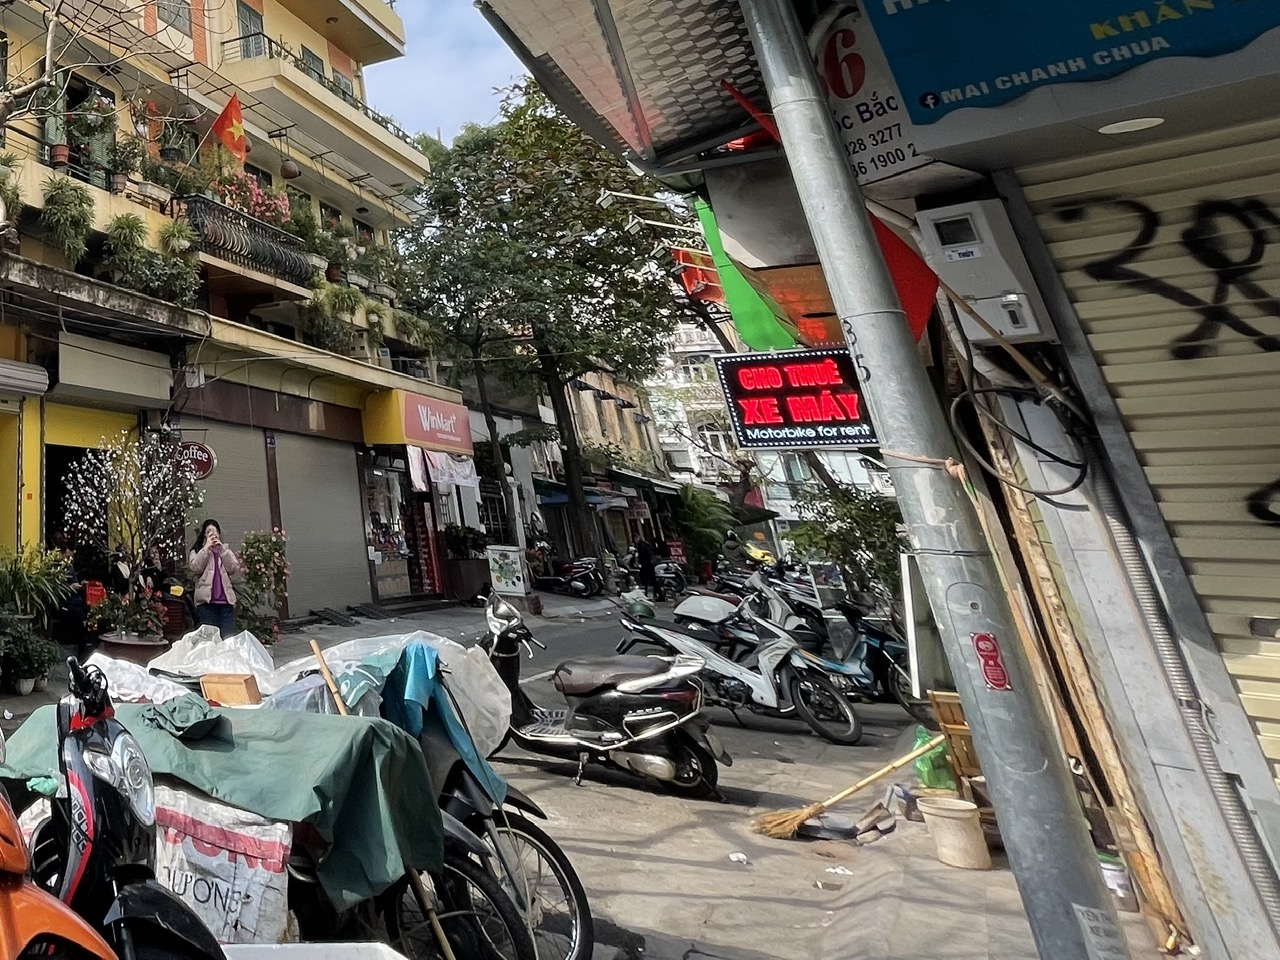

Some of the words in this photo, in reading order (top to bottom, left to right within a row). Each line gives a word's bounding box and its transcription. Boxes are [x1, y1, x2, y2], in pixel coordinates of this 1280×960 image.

[815, 28, 866, 99] 6
[941, 81, 990, 104] MAI
[994, 56, 1087, 90] CHANH
[1092, 36, 1172, 67] CHUA
[855, 91, 899, 123] Bắc
[869, 122, 902, 147] 3277
[870, 148, 905, 170] 1900
[738, 365, 783, 390] CHO
[784, 358, 843, 387] THUÊ
[738, 397, 784, 425] XE
[786, 390, 860, 424] MÁY
[746, 426, 816, 440] Motorbike
[817, 425, 838, 436] for
[840, 423, 870, 435] rent
[176, 445, 208, 462] Coffee
